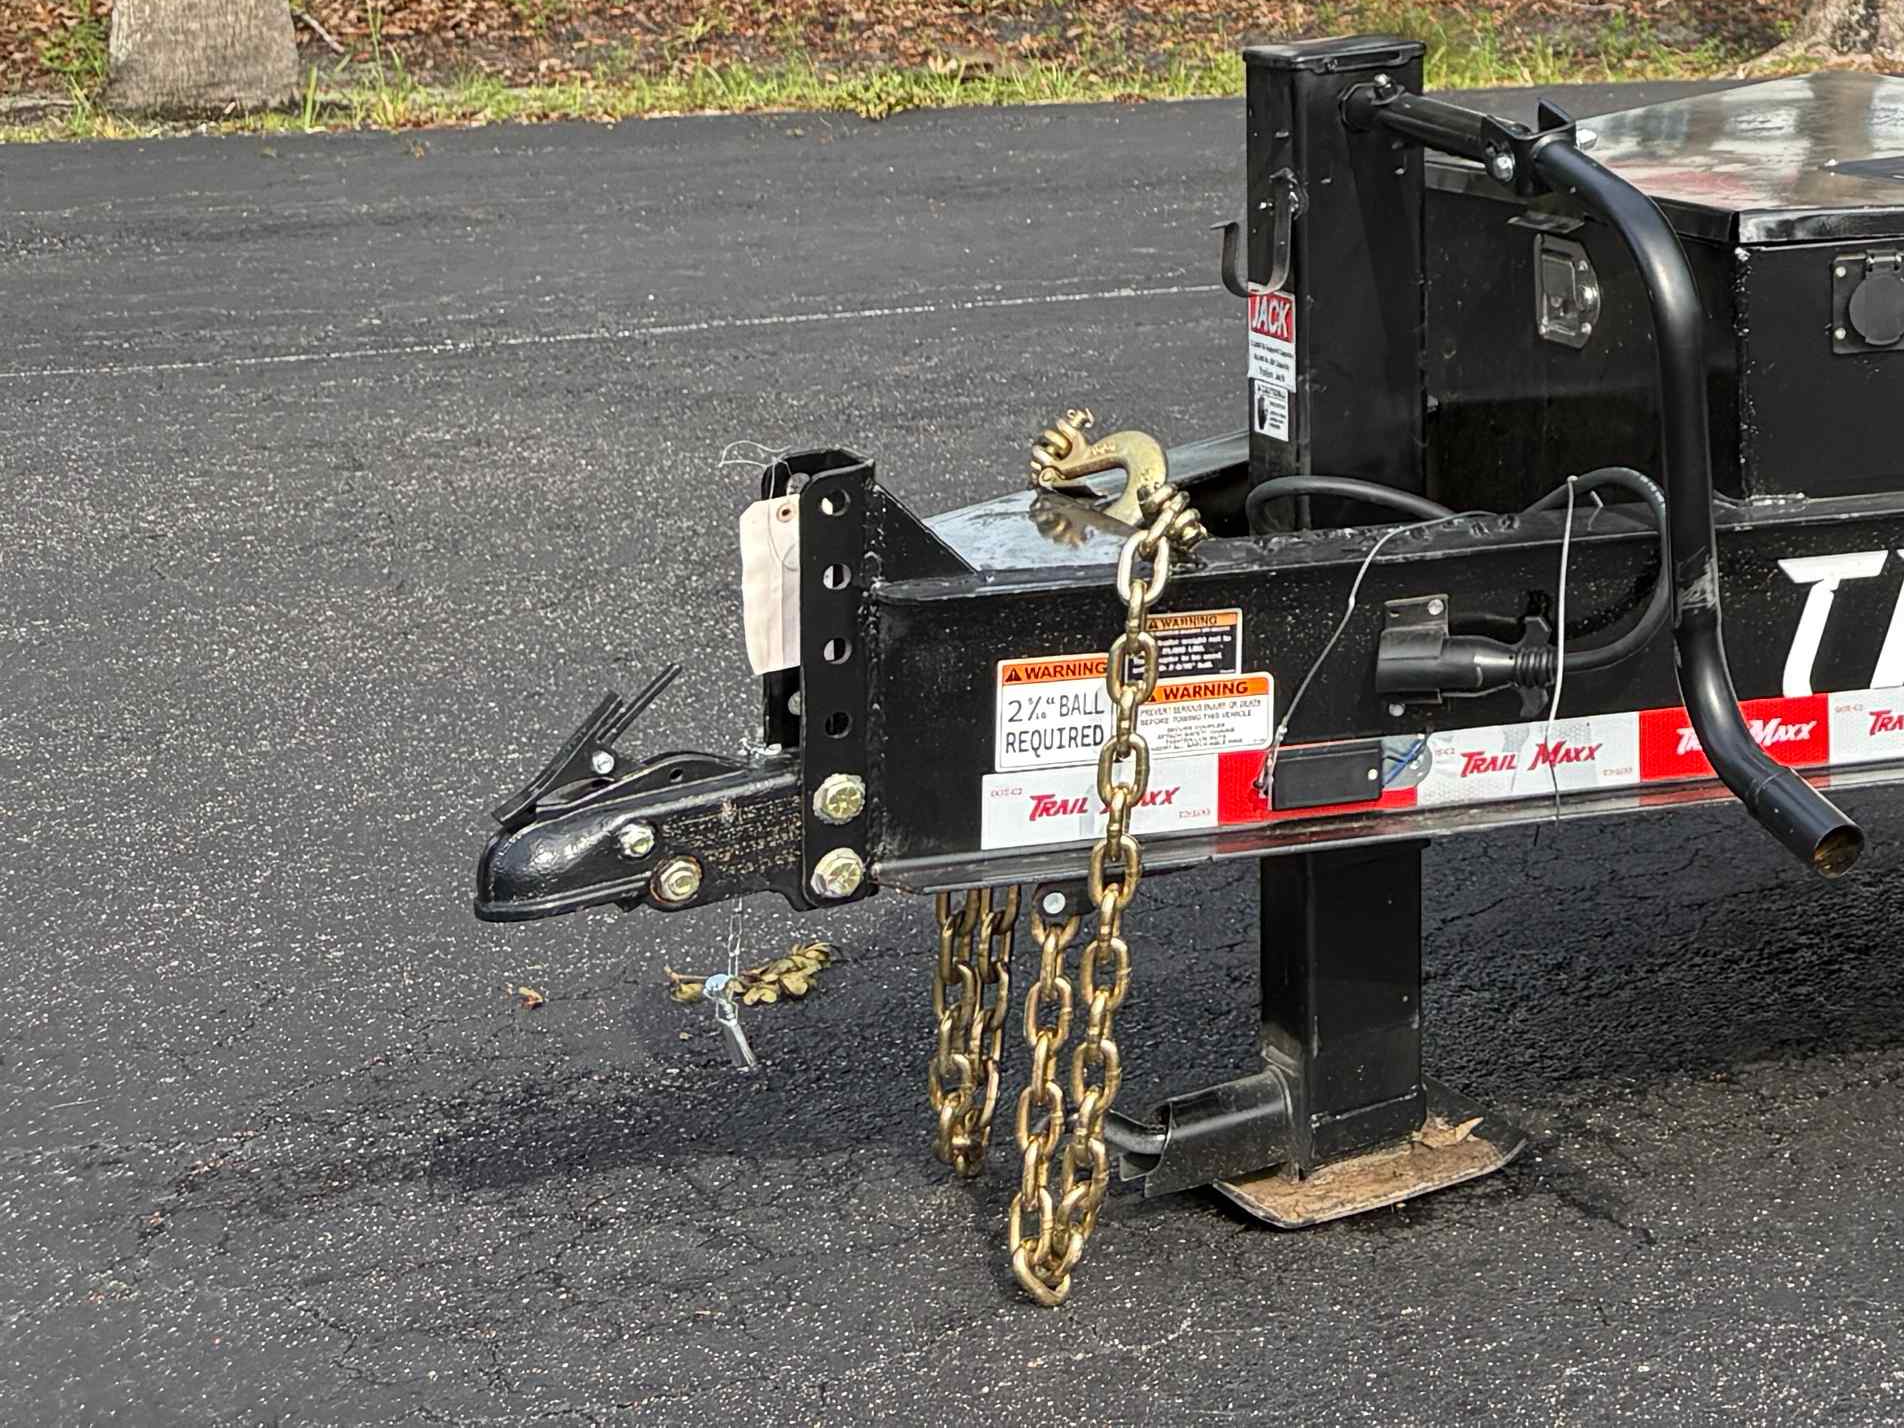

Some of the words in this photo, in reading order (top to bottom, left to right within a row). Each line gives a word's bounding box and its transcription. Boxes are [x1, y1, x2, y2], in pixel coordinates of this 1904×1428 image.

[1252, 295, 1290, 338] JACK
[1025, 661, 1108, 680] WARNING
[1059, 693, 1105, 717] BALL
[1164, 682, 1248, 700] WARNING
[1006, 724, 1104, 757] REQUIRED
[1460, 751, 1517, 777] TRAIL
[1528, 738, 1602, 771] MAXX
[1029, 794, 1089, 822] TRAIL
